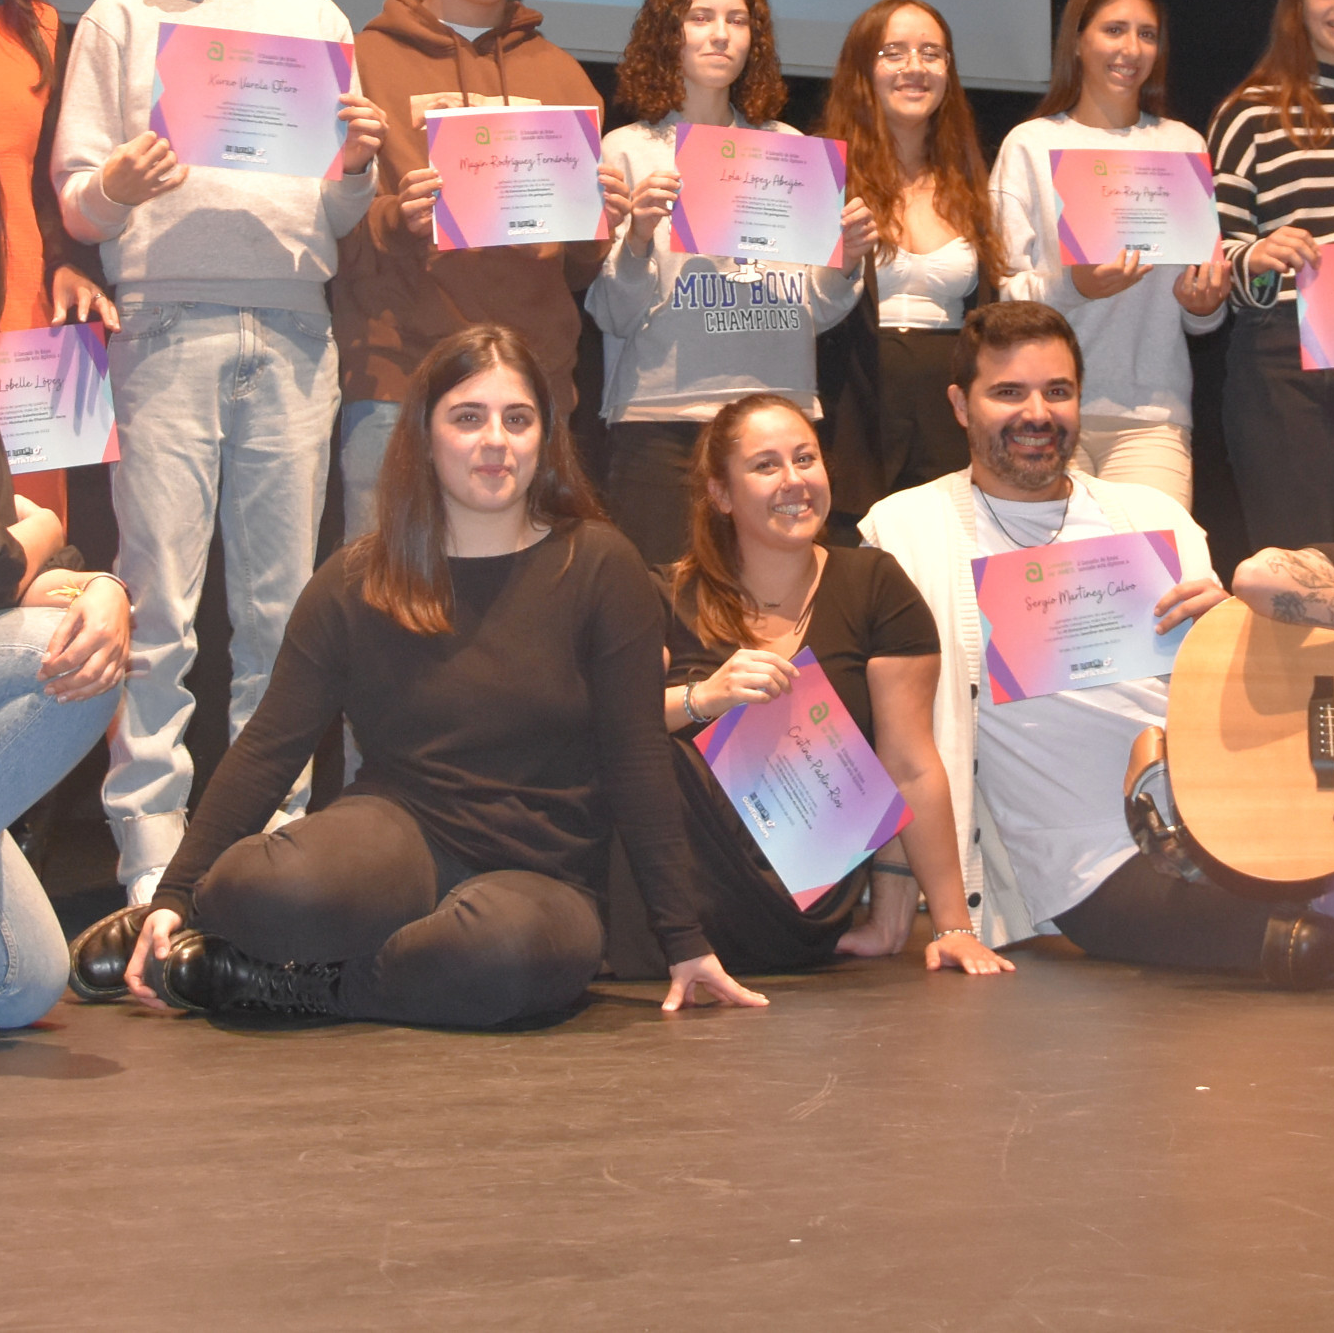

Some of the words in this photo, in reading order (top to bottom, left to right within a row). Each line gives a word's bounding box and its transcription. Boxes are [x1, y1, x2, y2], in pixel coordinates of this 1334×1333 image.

[672, 271, 737, 309] MUD
[706, 309, 800, 332] CHAMPIONS
[1025, 596, 1057, 614] Sergio
[1107, 580, 1137, 597] Calvo
